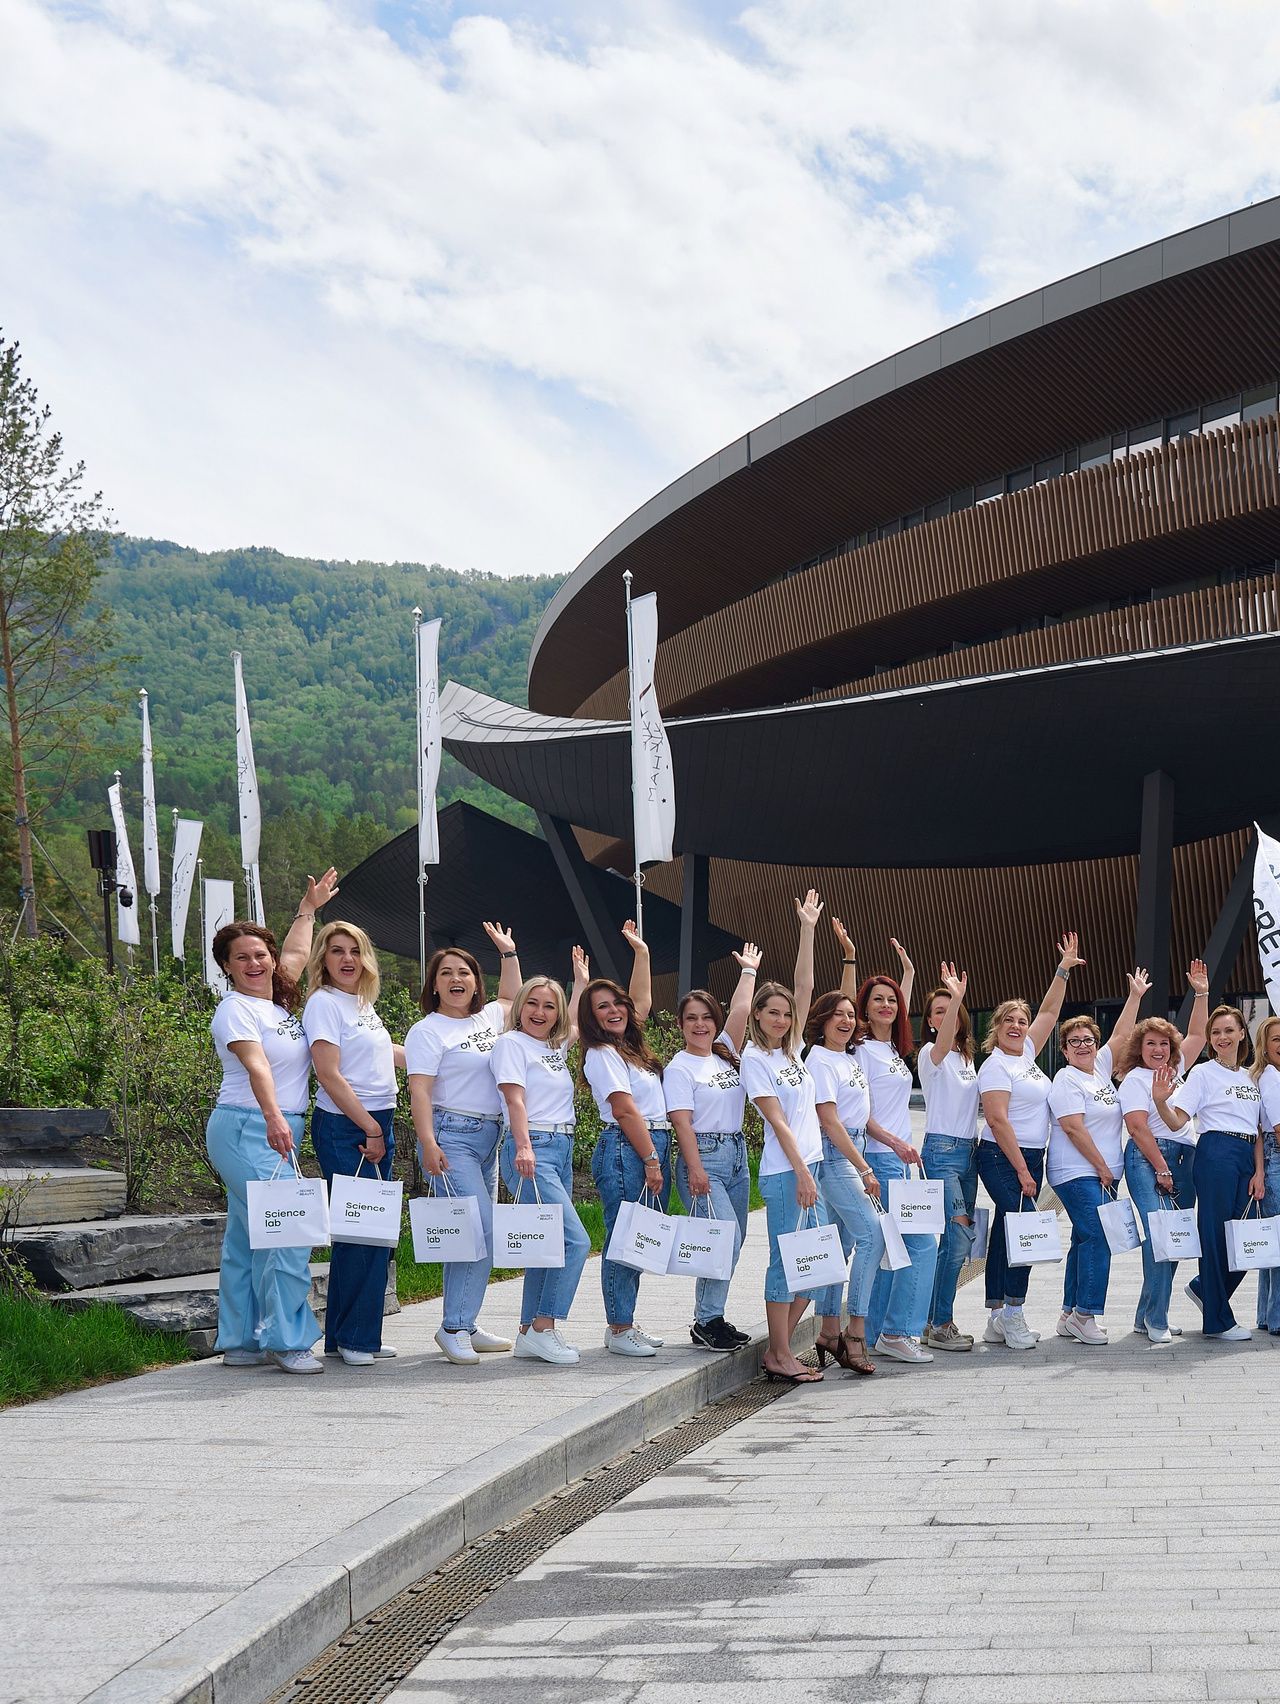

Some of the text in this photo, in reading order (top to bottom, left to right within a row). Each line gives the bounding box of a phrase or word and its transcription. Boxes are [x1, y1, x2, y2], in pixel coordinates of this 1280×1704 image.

[345, 1201, 386, 1212] Science
[900, 1203, 932, 1211] Science
[265, 1209, 306, 1219] Science
[345, 1209, 361, 1218] lab
[900, 1210, 913, 1218] lab
[265, 1219, 282, 1228] lab
[426, 1227, 460, 1235] Science
[426, 1236, 441, 1244] lab
[507, 1232, 545, 1240] Science
[636, 1232, 661, 1247] Science
[1019, 1232, 1048, 1241] Science
[507, 1241, 522, 1249] lab
[634, 1240, 645, 1249] lab
[679, 1242, 711, 1252] Science
[1242, 1240, 1269, 1248] Science
[678, 1250, 692, 1259] lab
[796, 1253, 829, 1265] Science
[797, 1263, 811, 1273] lab
